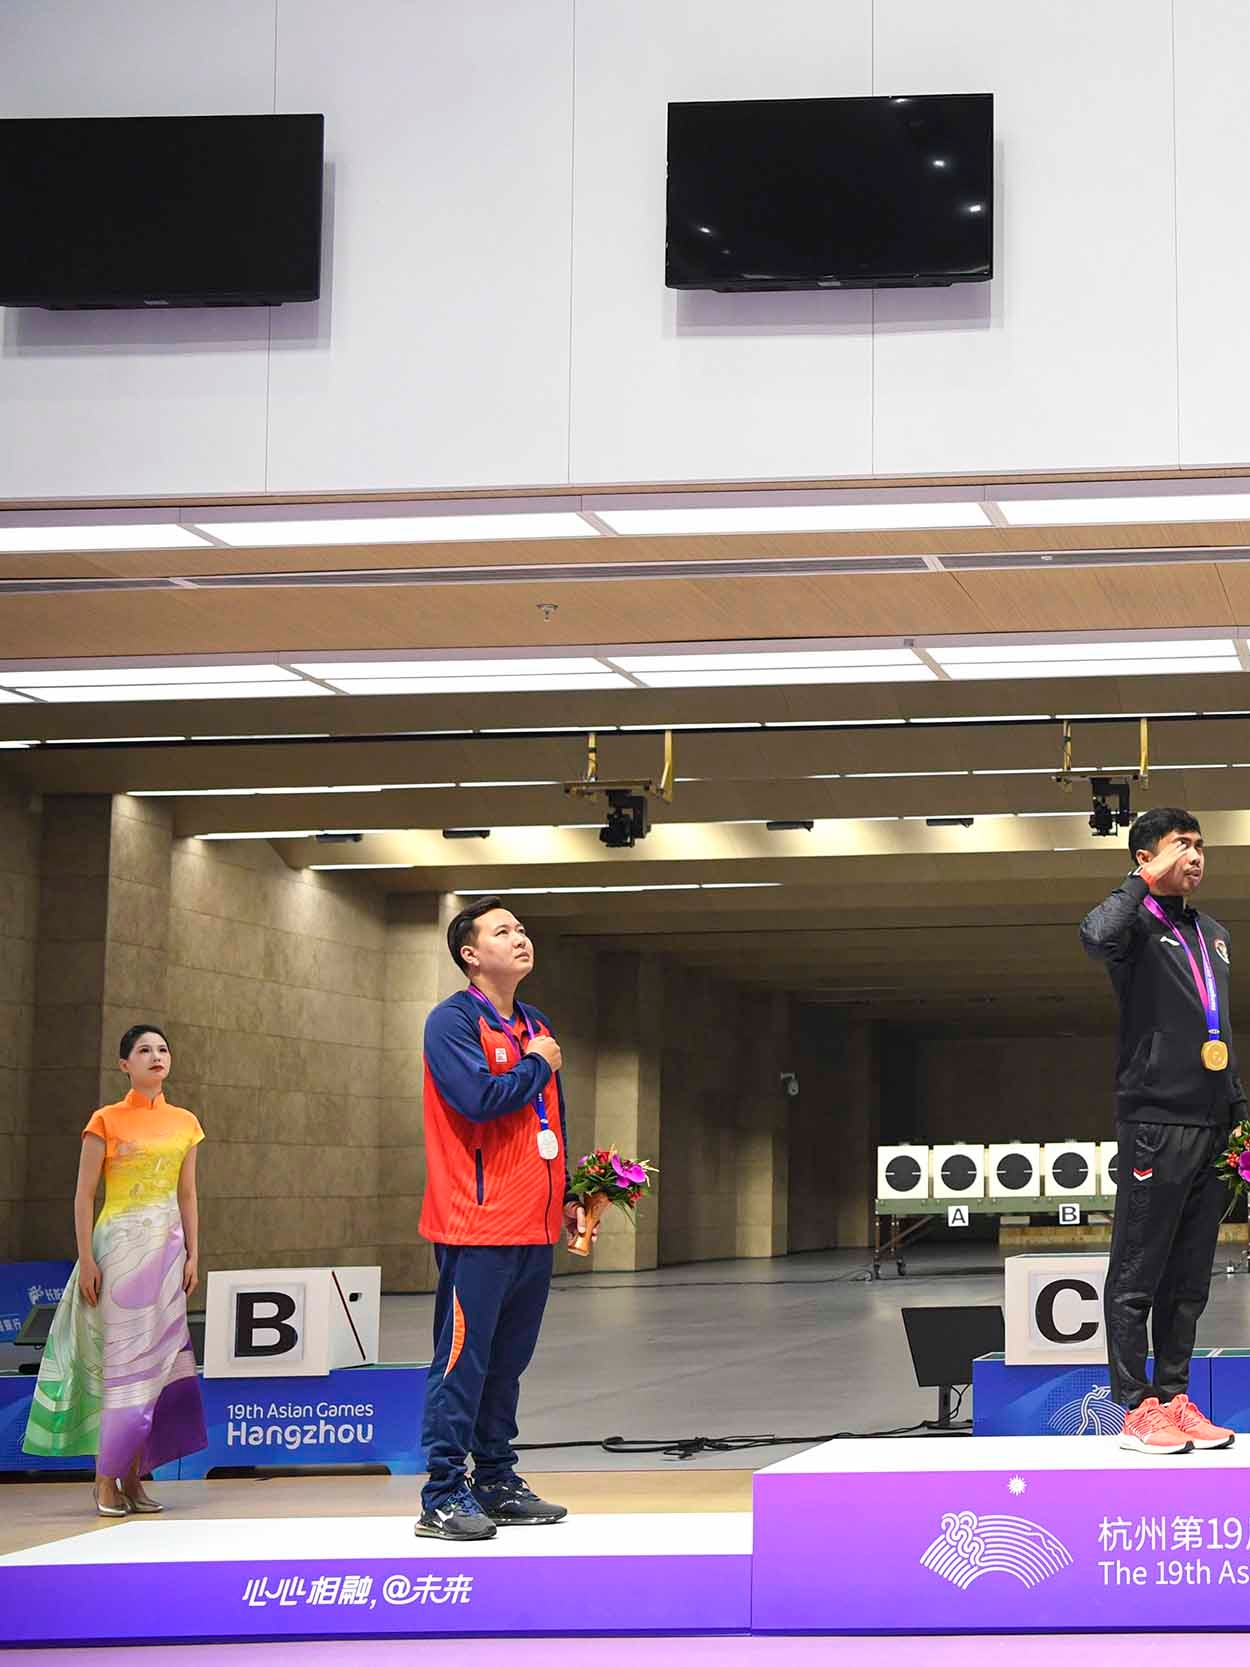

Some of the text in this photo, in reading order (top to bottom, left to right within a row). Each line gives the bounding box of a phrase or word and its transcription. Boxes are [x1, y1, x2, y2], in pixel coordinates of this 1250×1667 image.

[950, 1207, 967, 1225] A
[1061, 1205, 1077, 1222] B
[235, 1291, 298, 1358] B
[1034, 1278, 1100, 1345] C
[227, 1402, 374, 1420] 19th Asian Games
[227, 1420, 374, 1450] Hangzhou
[1098, 1560, 1148, 1585] The
[1155, 1559, 1211, 1585] 19th
